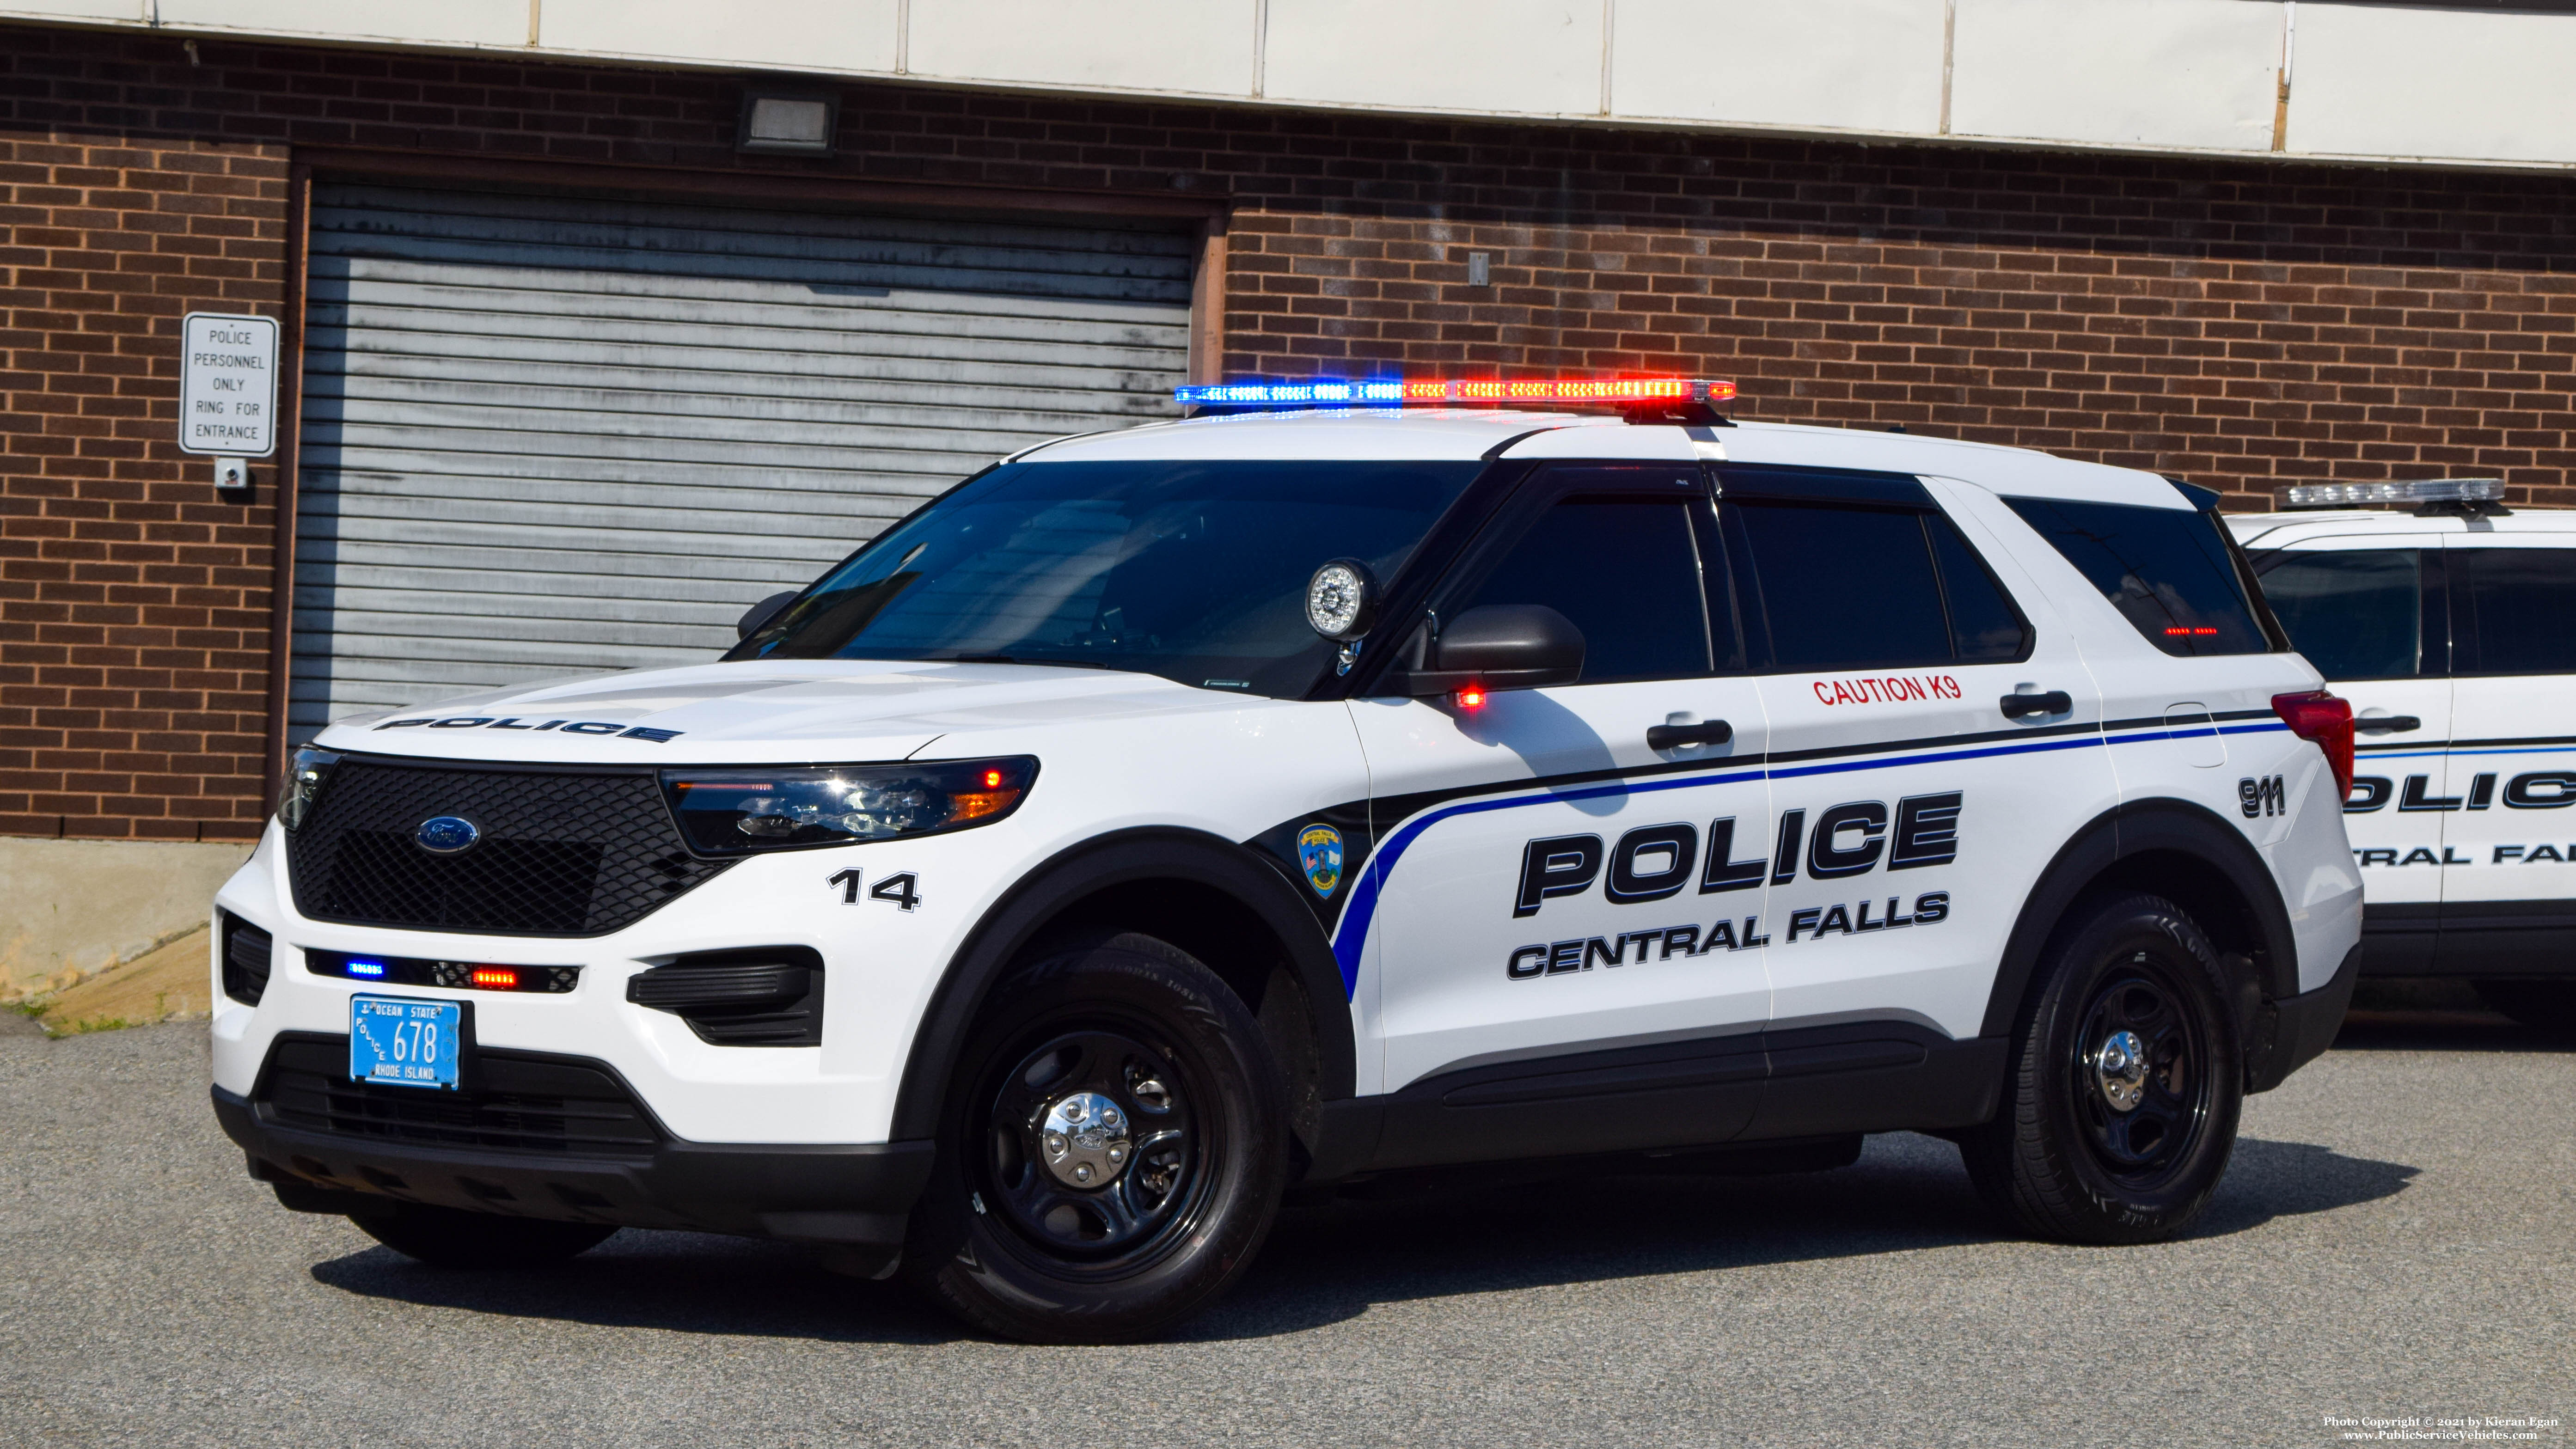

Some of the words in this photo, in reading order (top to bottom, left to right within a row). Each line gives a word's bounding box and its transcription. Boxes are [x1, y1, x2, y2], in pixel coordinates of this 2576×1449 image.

[209, 330, 252, 345] POLICE
[194, 353, 265, 369] PERSONNEL
[213, 378, 245, 391] ONLY
[196, 400, 224, 414] RING
[236, 403, 260, 416] FOR
[196, 424, 258, 440] ENTRANCE
[1813, 677, 1927, 706] CAUTION
[1926, 675, 1962, 699] K9
[372, 717, 687, 743] POLICE
[2238, 774, 2286, 819] 911
[2343, 771, 2576, 813] OLIC
[1512, 789, 1963, 919] POLICE
[826, 867, 922, 913] 14
[1506, 916, 1770, 981] CENTRAL
[1786, 890, 1950, 944] FALLS
[375, 1004, 403, 1017] OCEAN
[410, 1007, 437, 1019] STATE
[356, 1017, 385, 1061] POLICE
[393, 1021, 437, 1064] 678
[375, 1064, 400, 1078] RHODE
[404, 1066, 434, 1080] ISLAND
